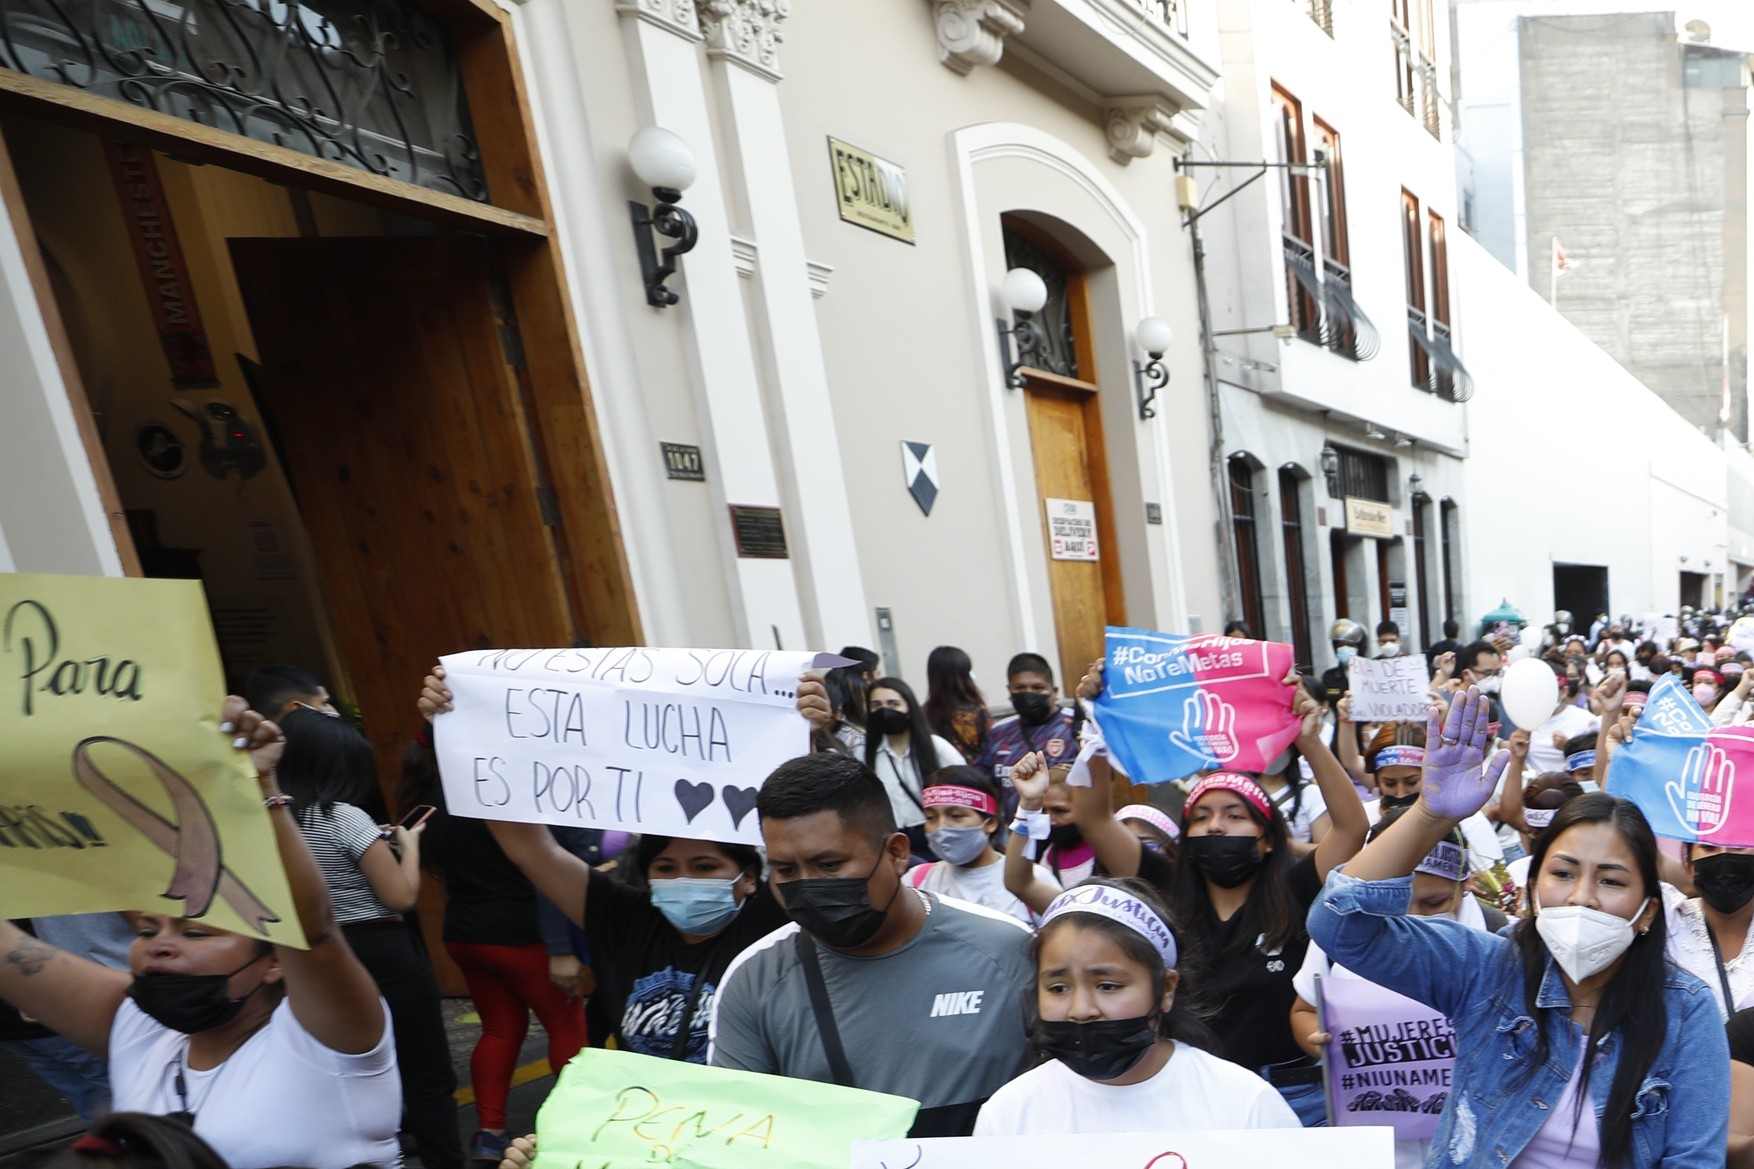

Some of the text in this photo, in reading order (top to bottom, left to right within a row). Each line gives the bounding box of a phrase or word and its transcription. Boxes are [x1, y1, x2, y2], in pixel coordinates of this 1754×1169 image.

[112, 140, 190, 326] MANCHESTE
[666, 452, 700, 471] 1047
[3, 600, 143, 716] Para
[1361, 678, 1419, 695] MUERTE
[1380, 659, 1405, 678] DE
[506, 687, 732, 763] ESTA LUCHA
[473, 756, 643, 823] ES POR TI
[930, 990, 985, 1017] NIKE
[592, 1086, 775, 1149] PENA
